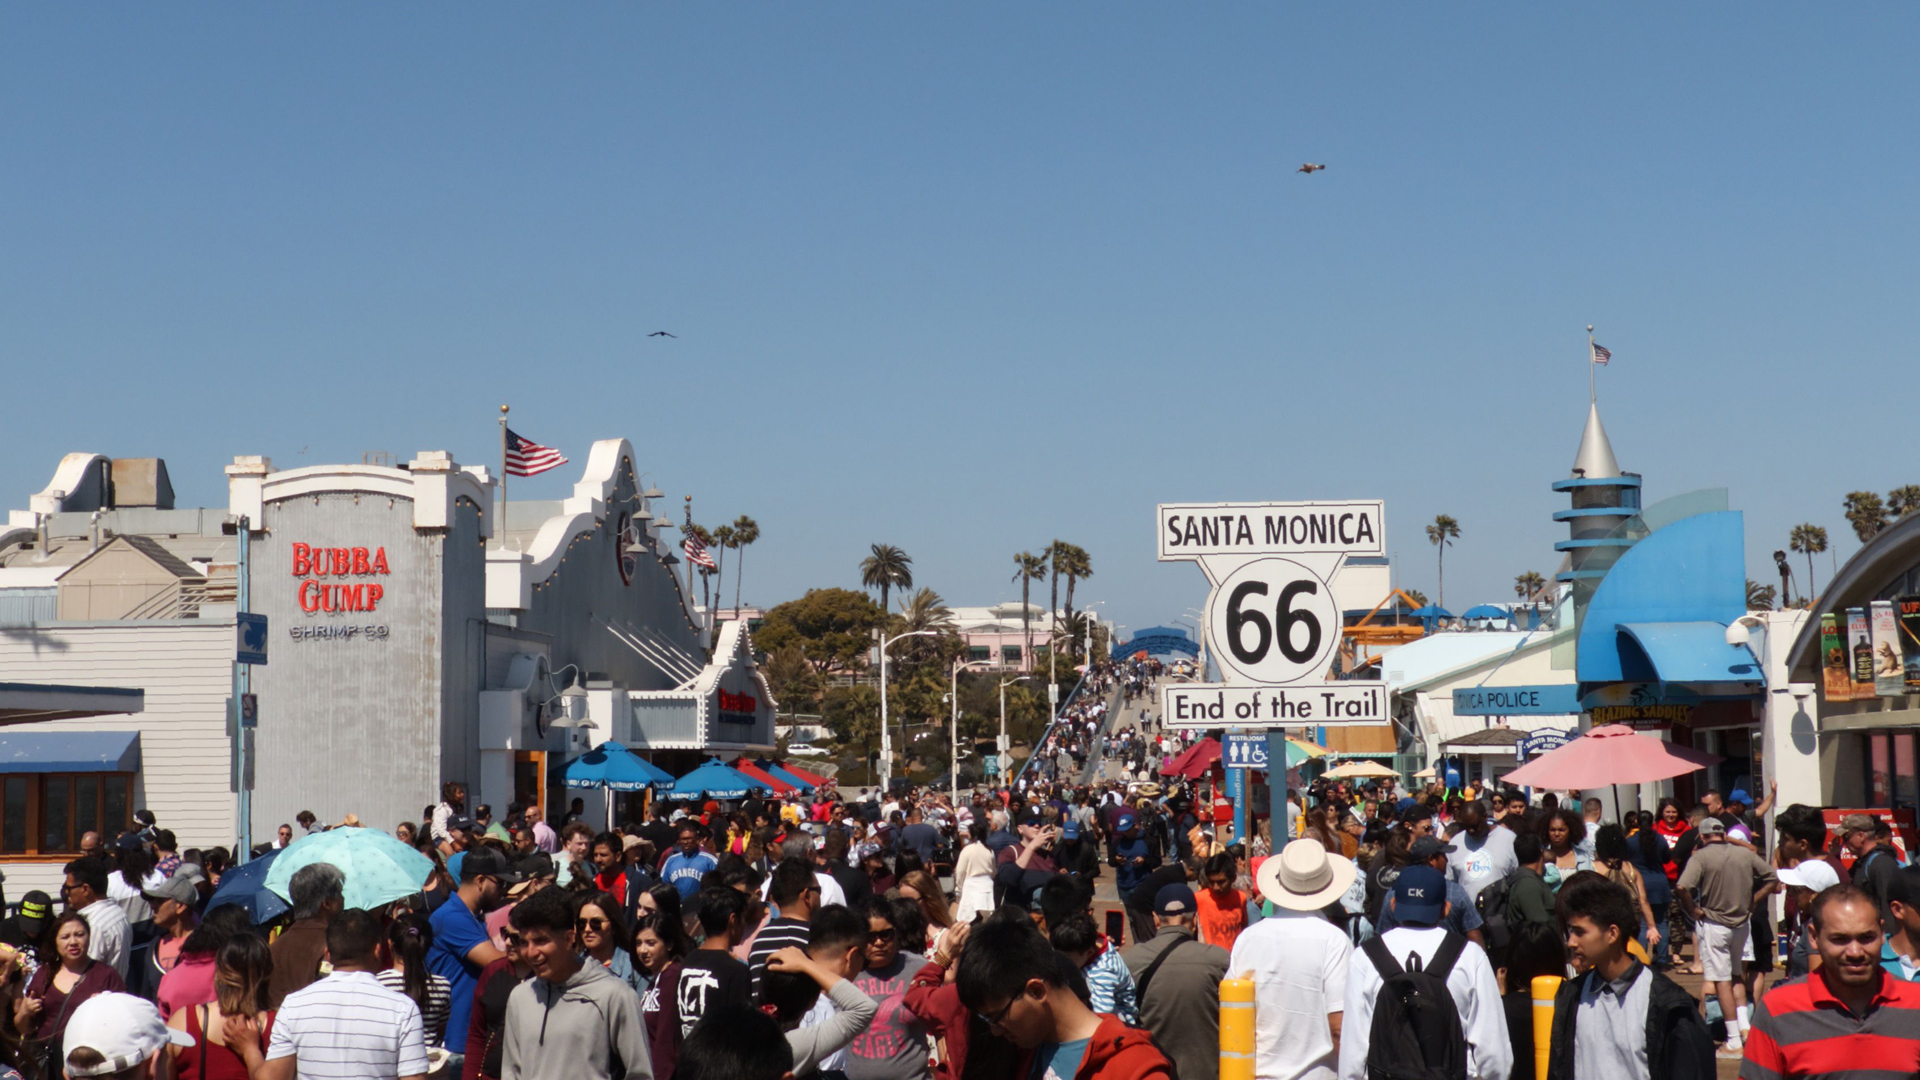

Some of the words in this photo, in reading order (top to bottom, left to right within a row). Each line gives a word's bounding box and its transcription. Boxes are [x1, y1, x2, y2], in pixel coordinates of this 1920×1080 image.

[1168, 515, 1254, 547] SANTA
[1265, 512, 1375, 545] MONICA
[291, 542, 391, 577] BUBBA
[298, 579, 384, 613] GUMP
[291, 624, 359, 641] SHRIMP
[1226, 579, 1322, 665] 66
[1176, 691, 1224, 719] End
[1235, 691, 1261, 719] of
[1271, 690, 1312, 718] the
[1321, 689, 1377, 718] Trail
[1455, 694, 1484, 710] ONICA
[1488, 691, 1540, 708] POLICE
[1592, 705, 1640, 727] BLAZING
[1643, 704, 1690, 722] SADDLES
[1525, 737, 1546, 749] SANTA
[1407, 887, 1425, 898] CK
